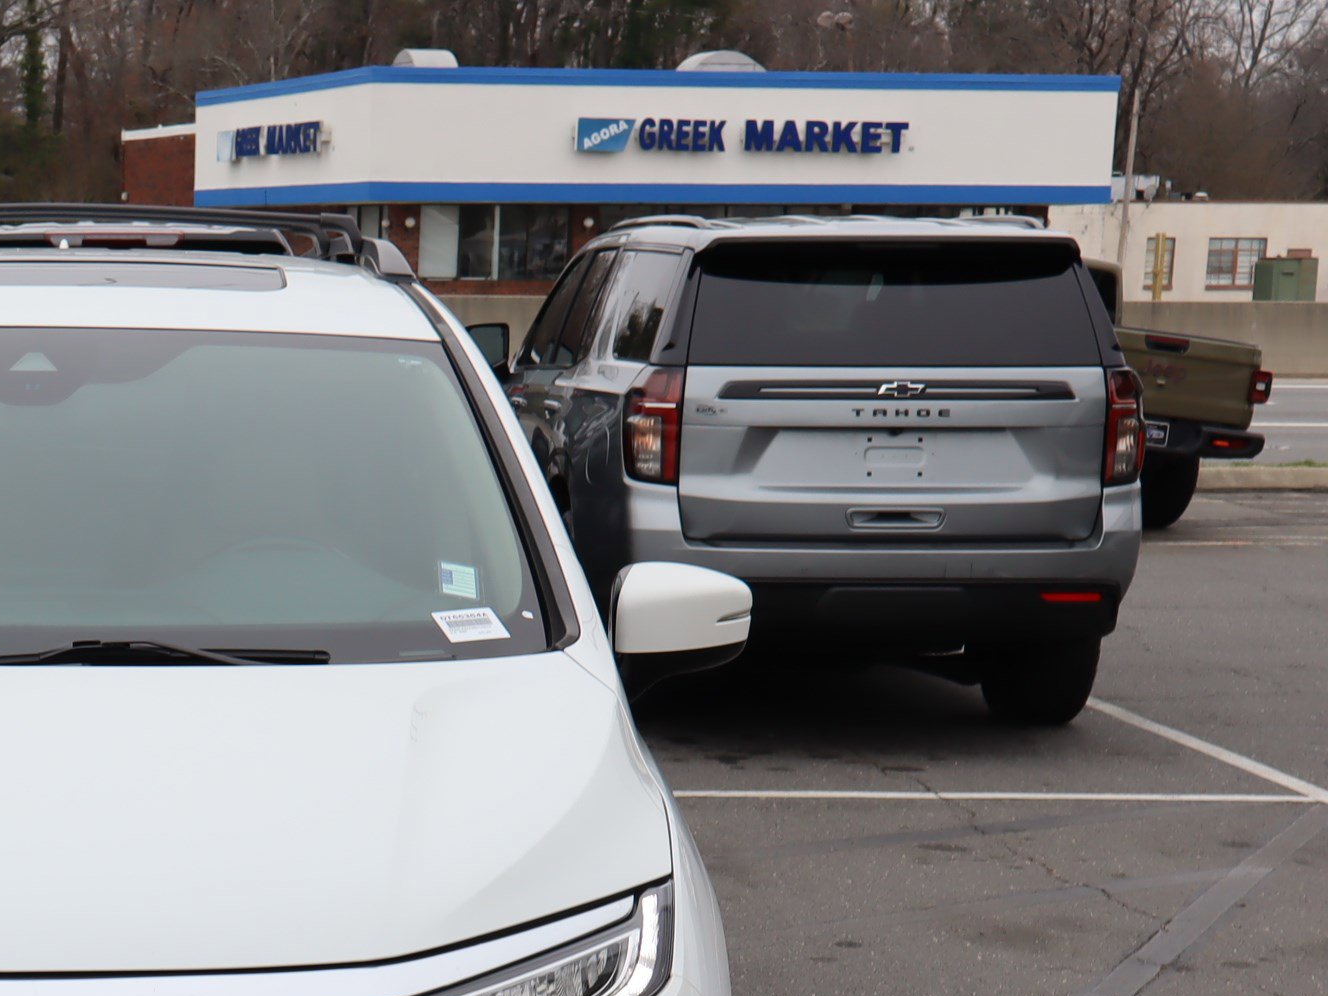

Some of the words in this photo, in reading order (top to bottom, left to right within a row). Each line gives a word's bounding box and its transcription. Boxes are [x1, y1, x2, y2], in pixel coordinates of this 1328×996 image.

[266, 121, 320, 154] MARKET
[583, 120, 628, 149] AGORA
[638, 118, 727, 152] GREEK
[744, 119, 909, 153] MARKET
[851, 408, 951, 417] TAHOE
